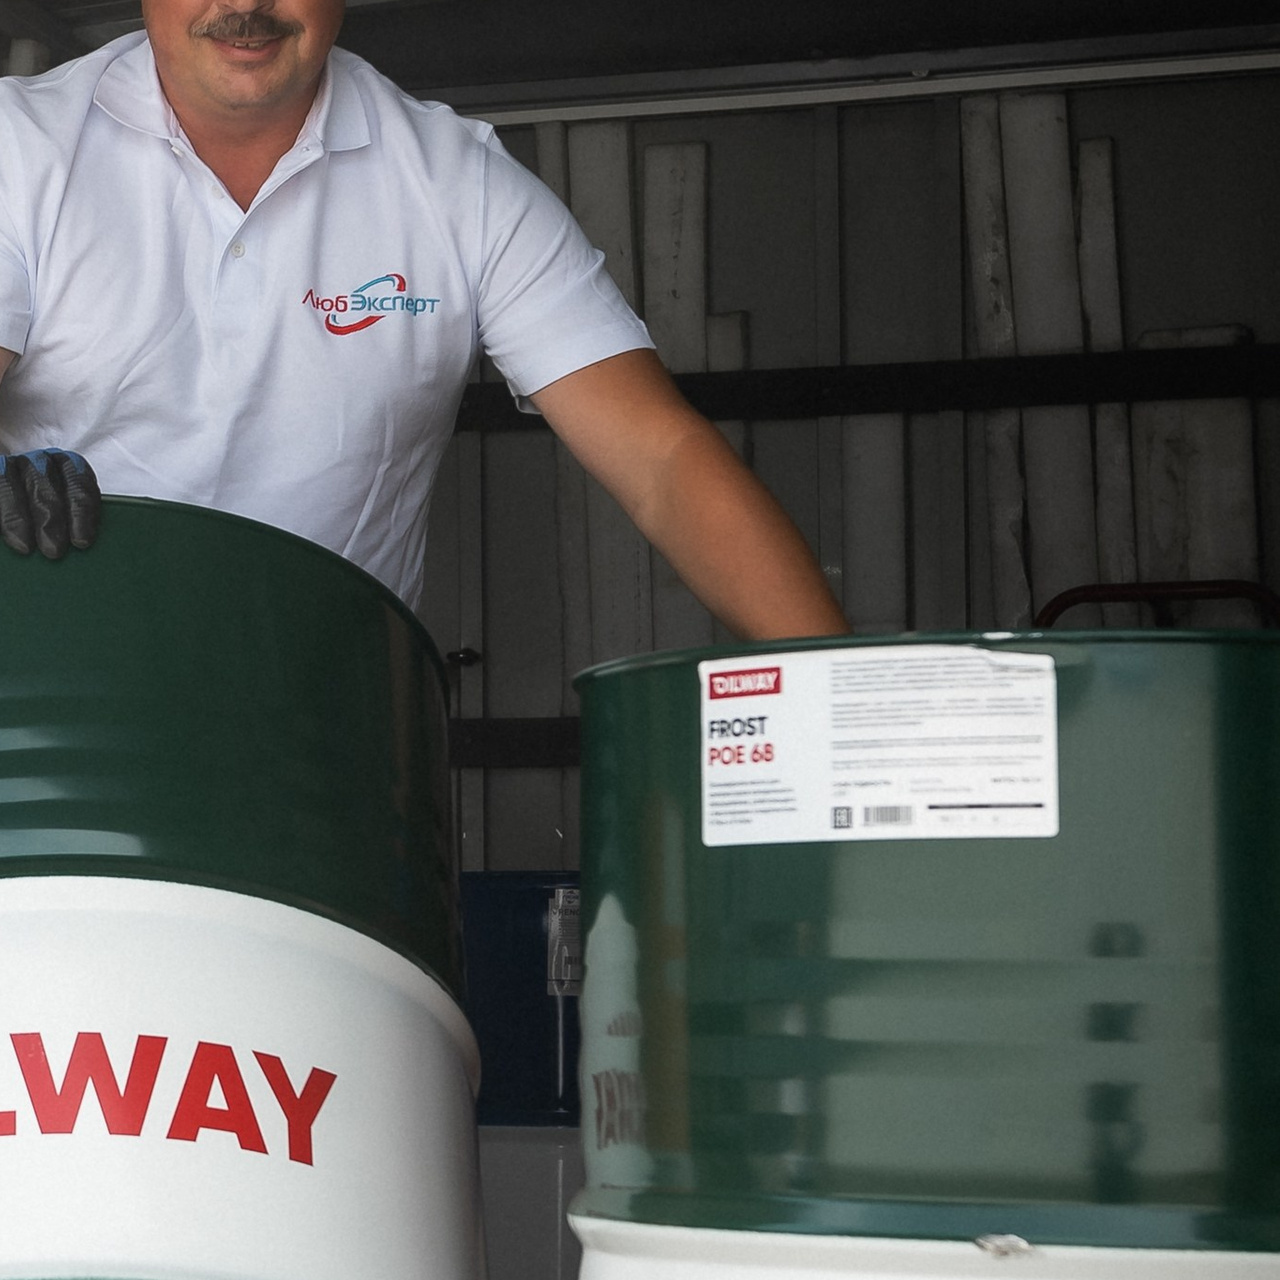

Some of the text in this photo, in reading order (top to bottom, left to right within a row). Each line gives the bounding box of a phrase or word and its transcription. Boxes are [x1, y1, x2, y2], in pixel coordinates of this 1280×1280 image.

[711, 671, 778, 695] OILWAY
[708, 716, 768, 739] FROST
[708, 743, 774, 766] POE 68
